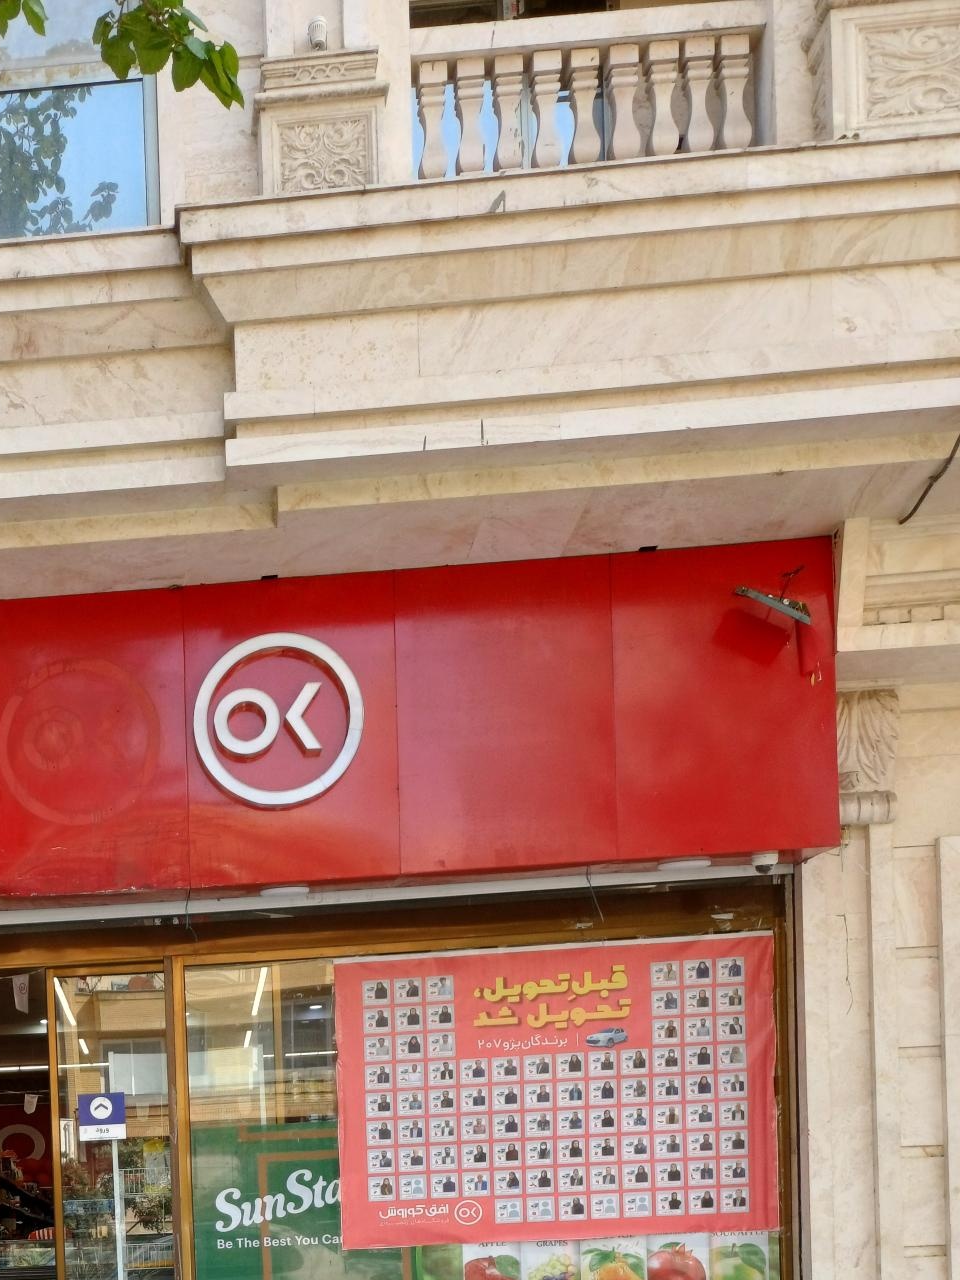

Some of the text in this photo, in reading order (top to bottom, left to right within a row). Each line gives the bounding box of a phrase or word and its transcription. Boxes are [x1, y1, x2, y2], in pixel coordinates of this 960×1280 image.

[473, 998, 632, 1029] تحویل شد
[502, 1037, 521, 1051] پژو
[521, 1033, 568, 1050] برندگان
[379, 1203, 449, 1220] افق کوروش
[217, 1233, 343, 1249] Be The Best You Ca
[536, 1240, 569, 1248] GRAPES
